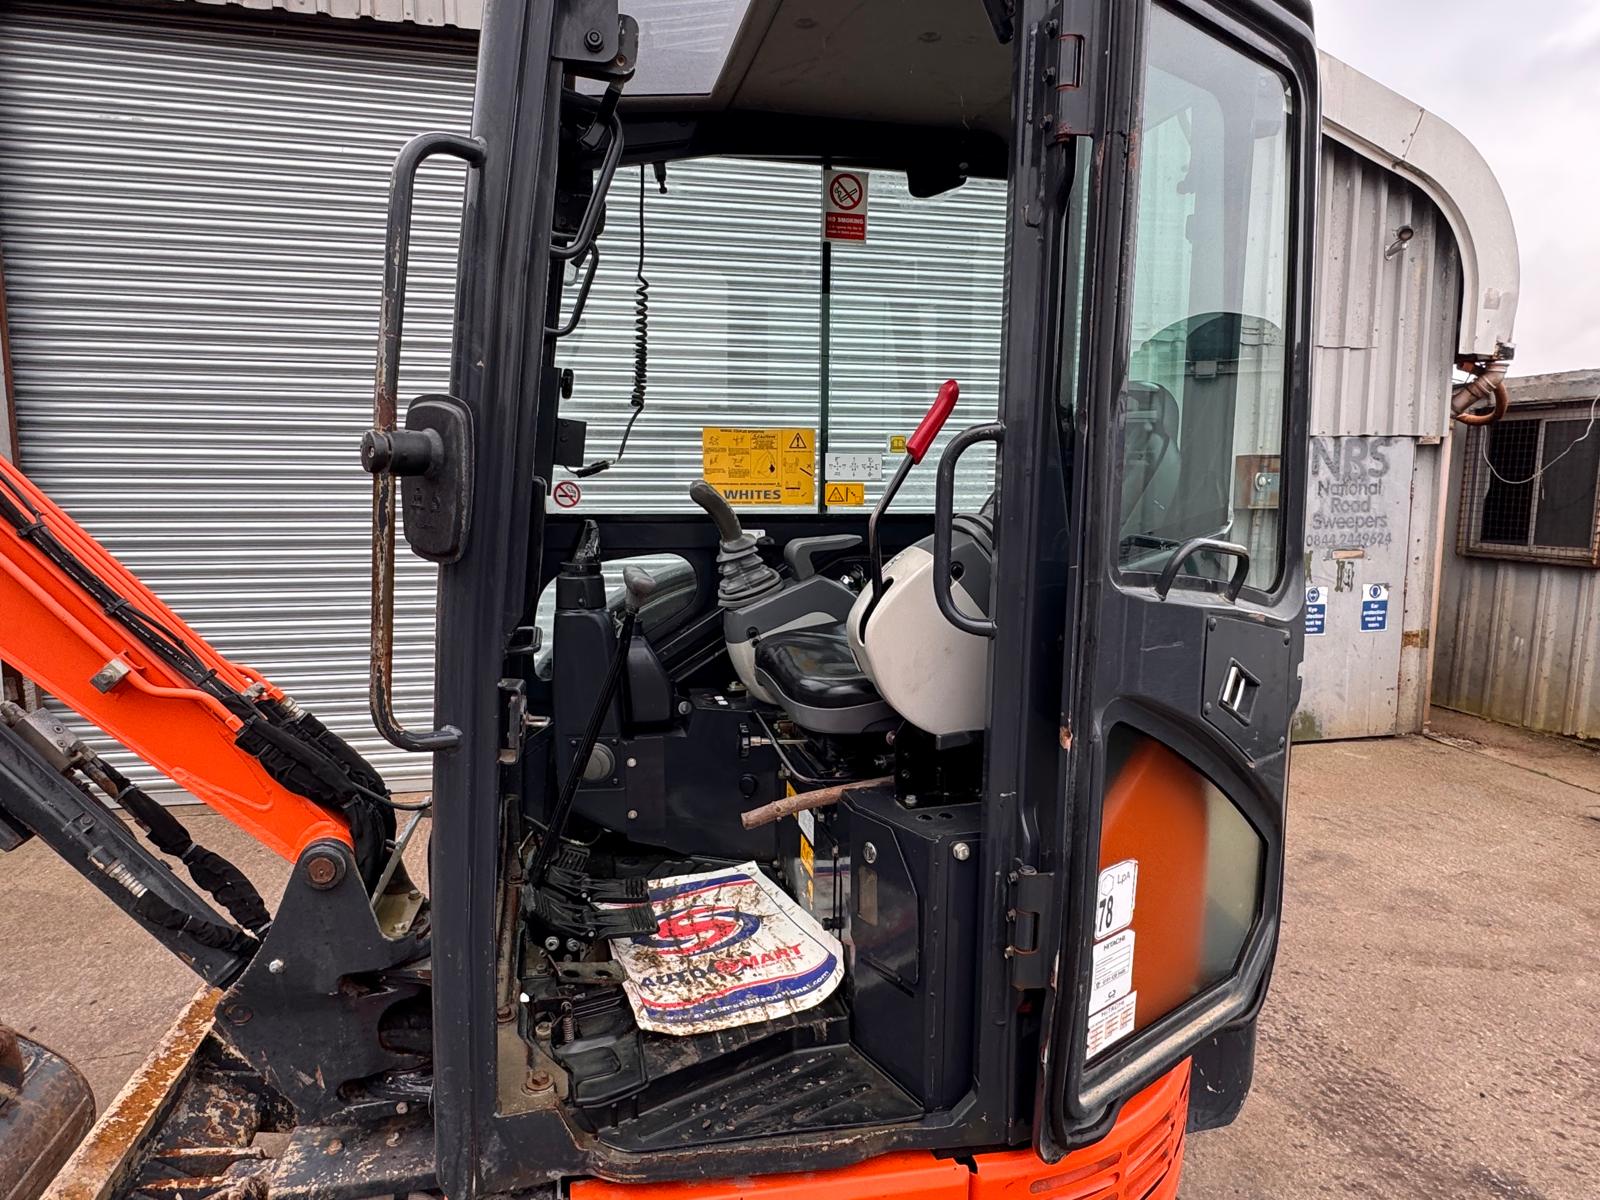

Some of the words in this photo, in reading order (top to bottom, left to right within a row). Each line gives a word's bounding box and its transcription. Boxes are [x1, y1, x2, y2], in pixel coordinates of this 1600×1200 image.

[1311, 437, 1391, 481] NRS
[724, 489, 781, 500] WHITES
[1318, 478, 1382, 497] National
[1331, 495, 1371, 513] Road
[1312, 511, 1388, 533] Sweepers
[1306, 533, 1336, 547] 0844
[1099, 895, 1113, 932] 78
